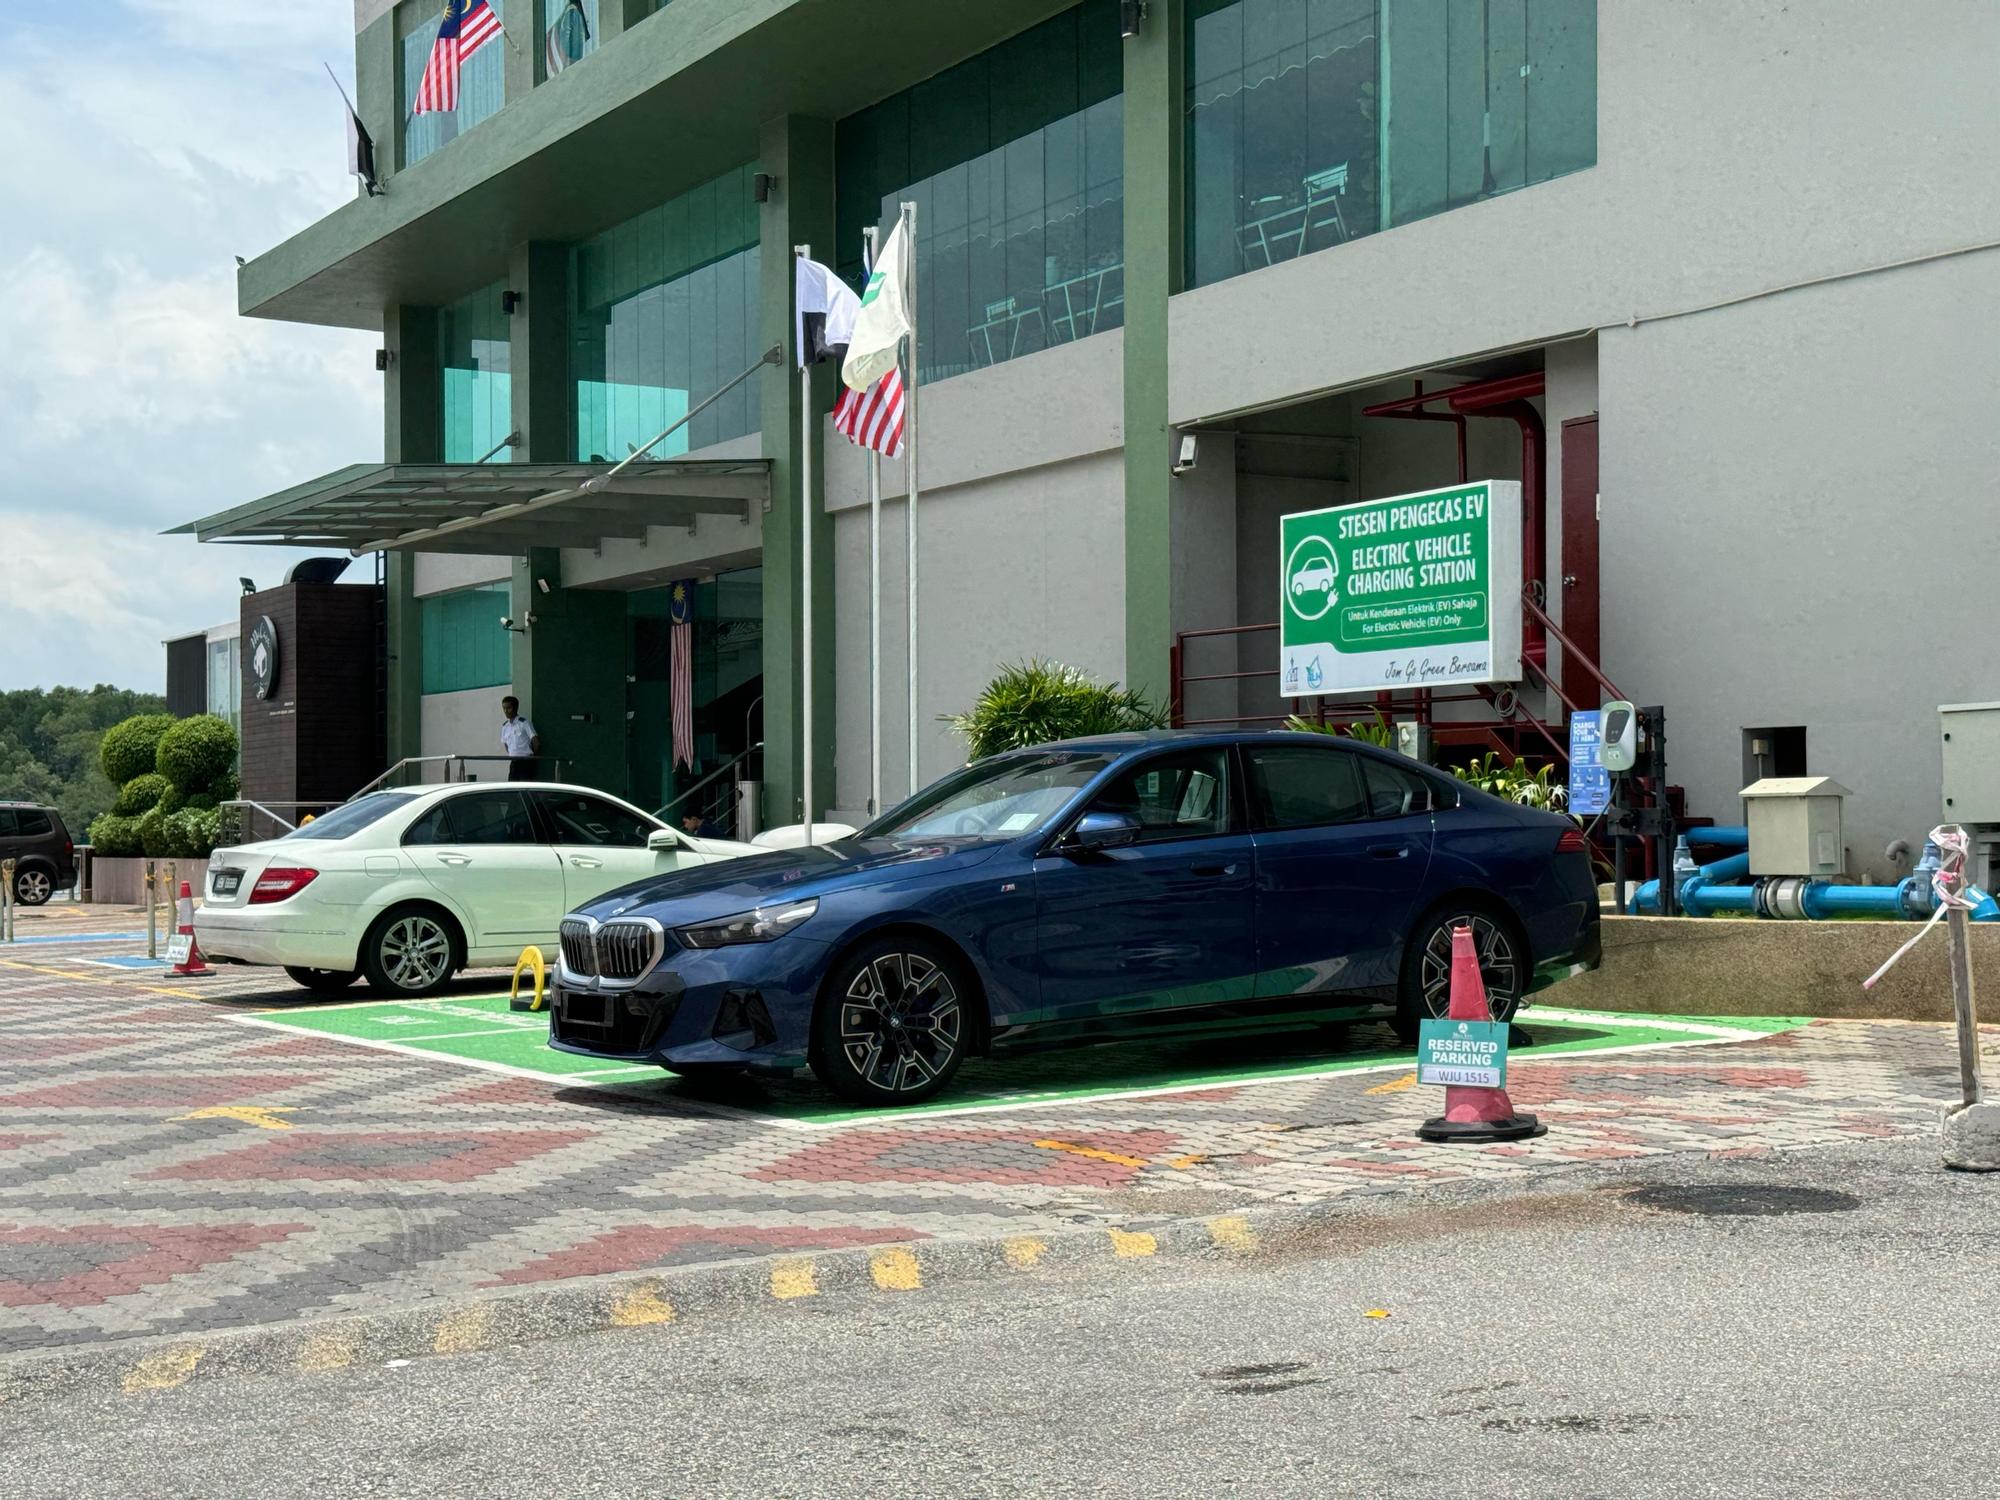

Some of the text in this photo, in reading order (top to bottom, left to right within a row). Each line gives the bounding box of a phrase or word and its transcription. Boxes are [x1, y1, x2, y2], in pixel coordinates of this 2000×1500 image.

[1339, 494, 1484, 539] STESEN PENGECAS EV
[1352, 532, 1472, 571] ELECTRIC VEHICLE
[1347, 558, 1476, 596] CHARGING STATION
[1347, 597, 1477, 621] Untuk Kenderaan Elektrik (EV) Sahaja
[1362, 613, 1461, 633] For Electric Vehicle (EV) Only
[1405, 659, 1417, 683] Go
[1420, 658, 1446, 682] Green
[1449, 655, 1487, 675] Bersama
[1428, 1039, 1498, 1054] RESERVED
[1432, 1052, 1492, 1065] PARKING
[1464, 1072, 1489, 1083] 1515
